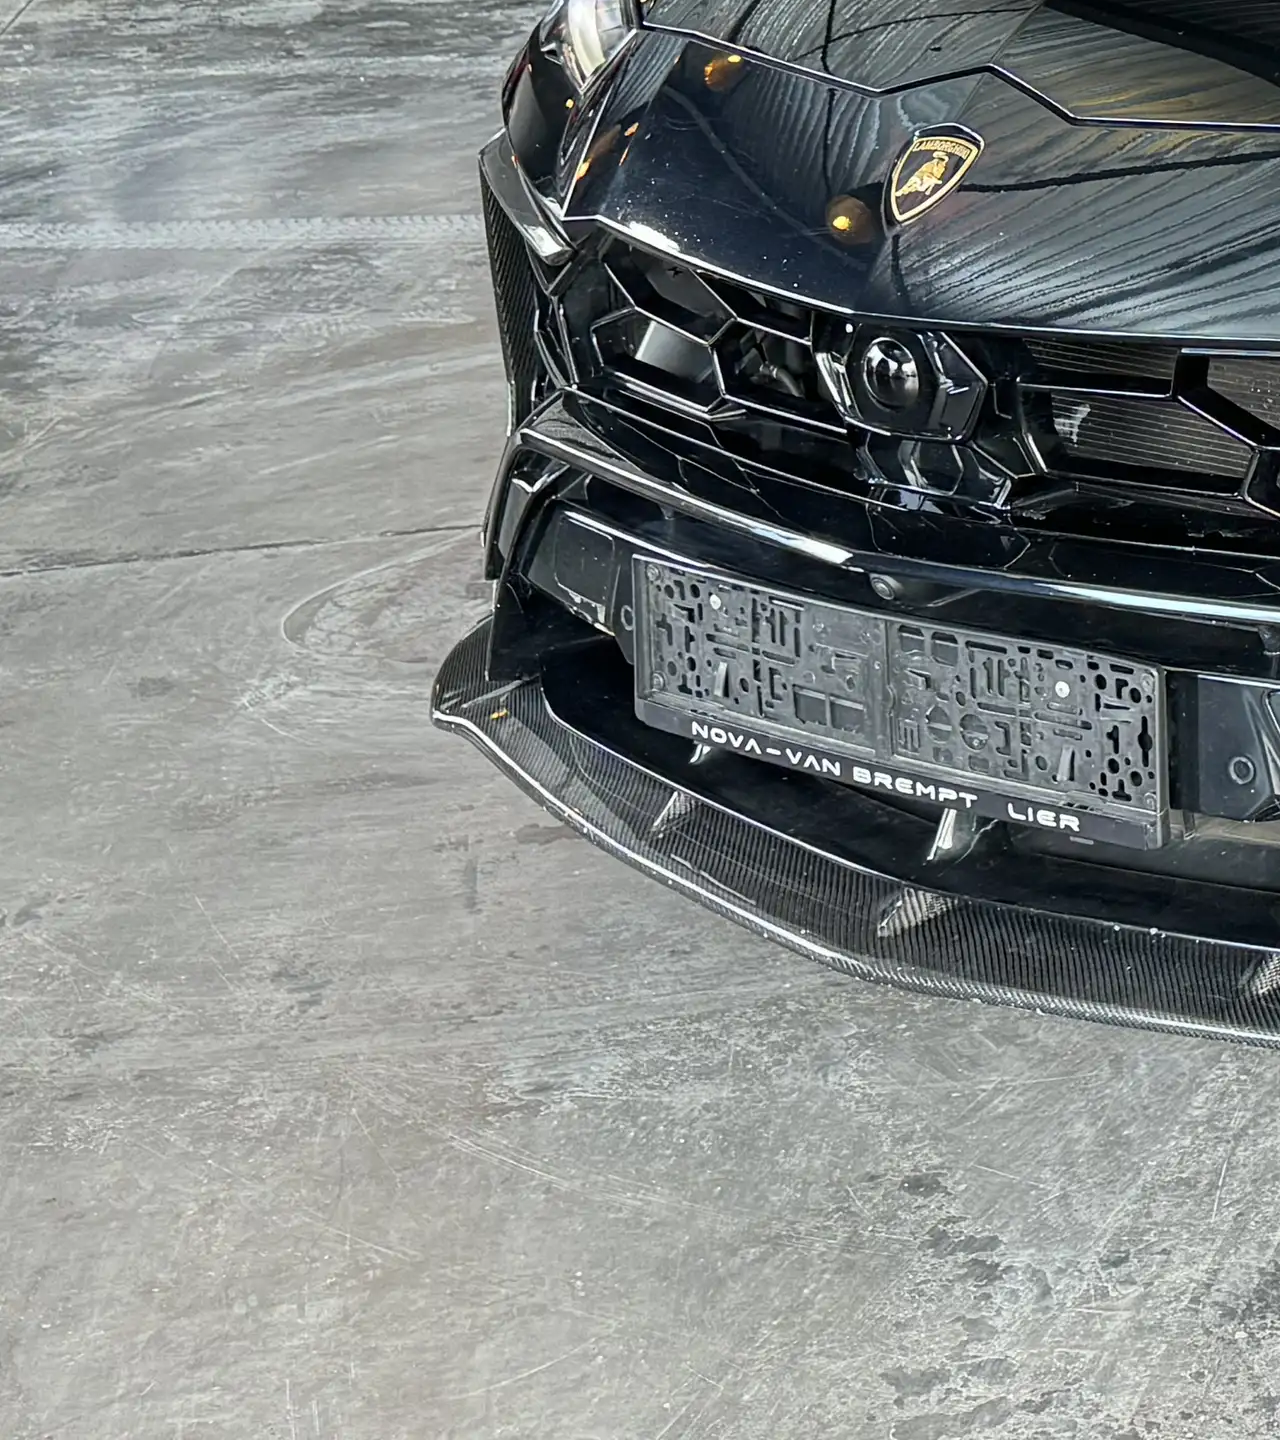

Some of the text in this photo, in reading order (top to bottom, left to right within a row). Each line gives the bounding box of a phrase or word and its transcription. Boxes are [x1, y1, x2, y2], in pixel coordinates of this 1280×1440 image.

[912, 139, 972, 160] LAMBORGHINI
[691, 720, 1081, 833] NOVA-VAN BREMPT LIER
